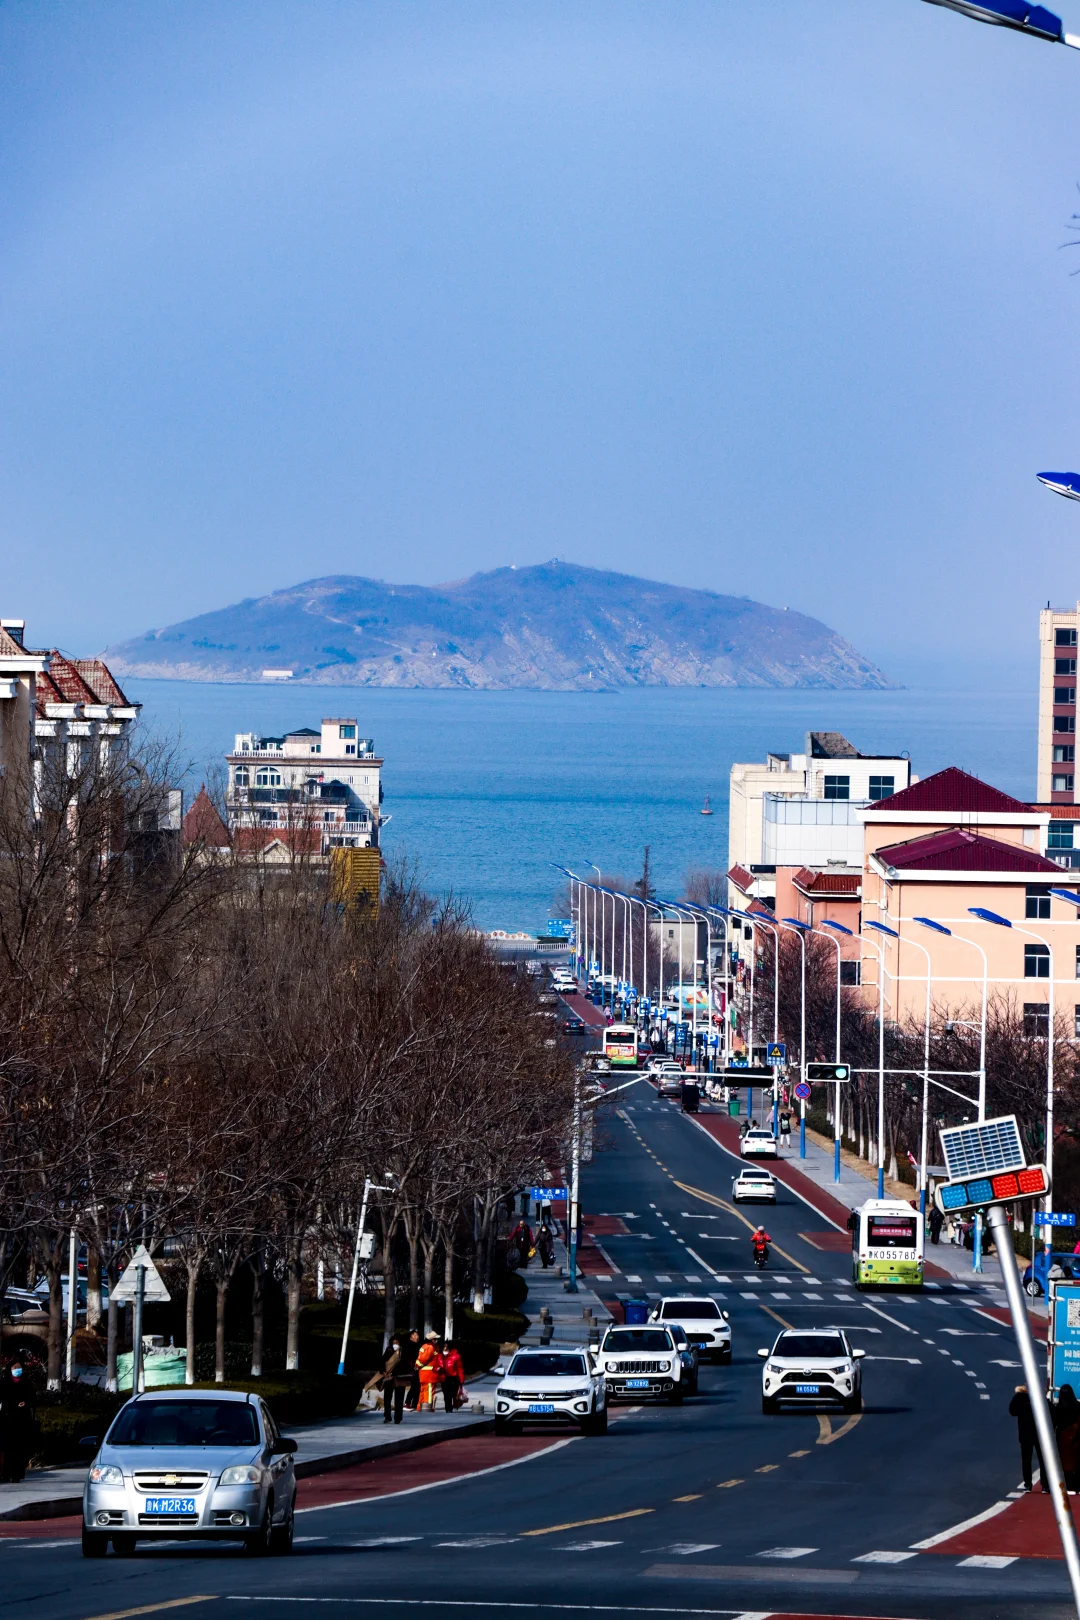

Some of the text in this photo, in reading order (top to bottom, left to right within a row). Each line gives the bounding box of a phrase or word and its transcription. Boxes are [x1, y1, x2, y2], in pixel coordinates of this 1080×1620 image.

[591, 961, 598, 971] P
[621, 983, 628, 992] P
[708, 1035, 716, 1046] P
